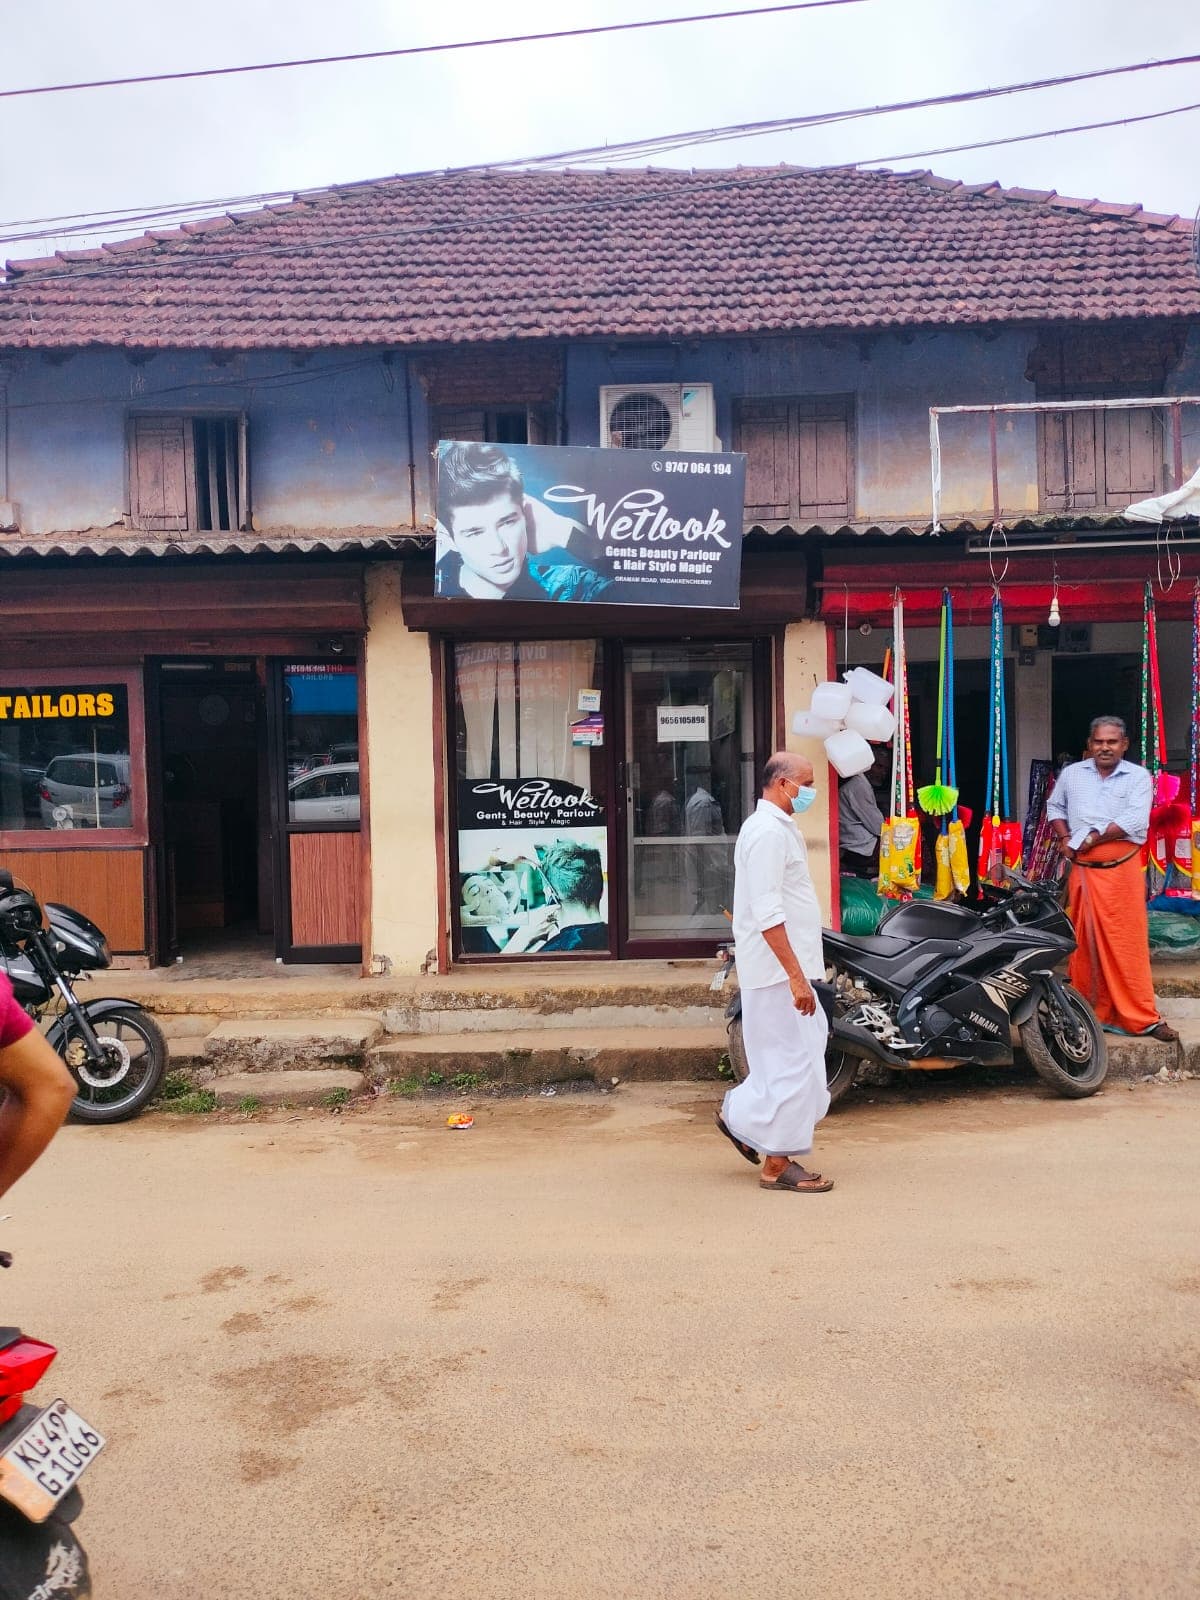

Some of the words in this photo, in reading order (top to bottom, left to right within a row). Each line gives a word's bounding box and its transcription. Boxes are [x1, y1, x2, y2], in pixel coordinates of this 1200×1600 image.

[665, 461, 689, 473] 9747
[690, 462, 711, 474] 064
[712, 463, 732, 475] 194
[544, 485, 732, 548] Wetlook
[605, 545, 637, 558] Gents
[639, 547, 679, 560] Beauty
[680, 549, 721, 561] Parlour
[613, 560, 621, 570] &
[623, 560, 647, 571] Hair
[648, 560, 677, 573] Style
[678, 562, 713, 574] Magic
[0, 693, 114, 719] TAILORS
[472, 780, 598, 810] Wetlook
[476, 811, 507, 820] Gents
[513, 810, 550, 820] Beauty
[557, 808, 595, 818] Parlour
[551, 818, 571, 826] Magic
[968, 1010, 1000, 1034] YAMAHA
